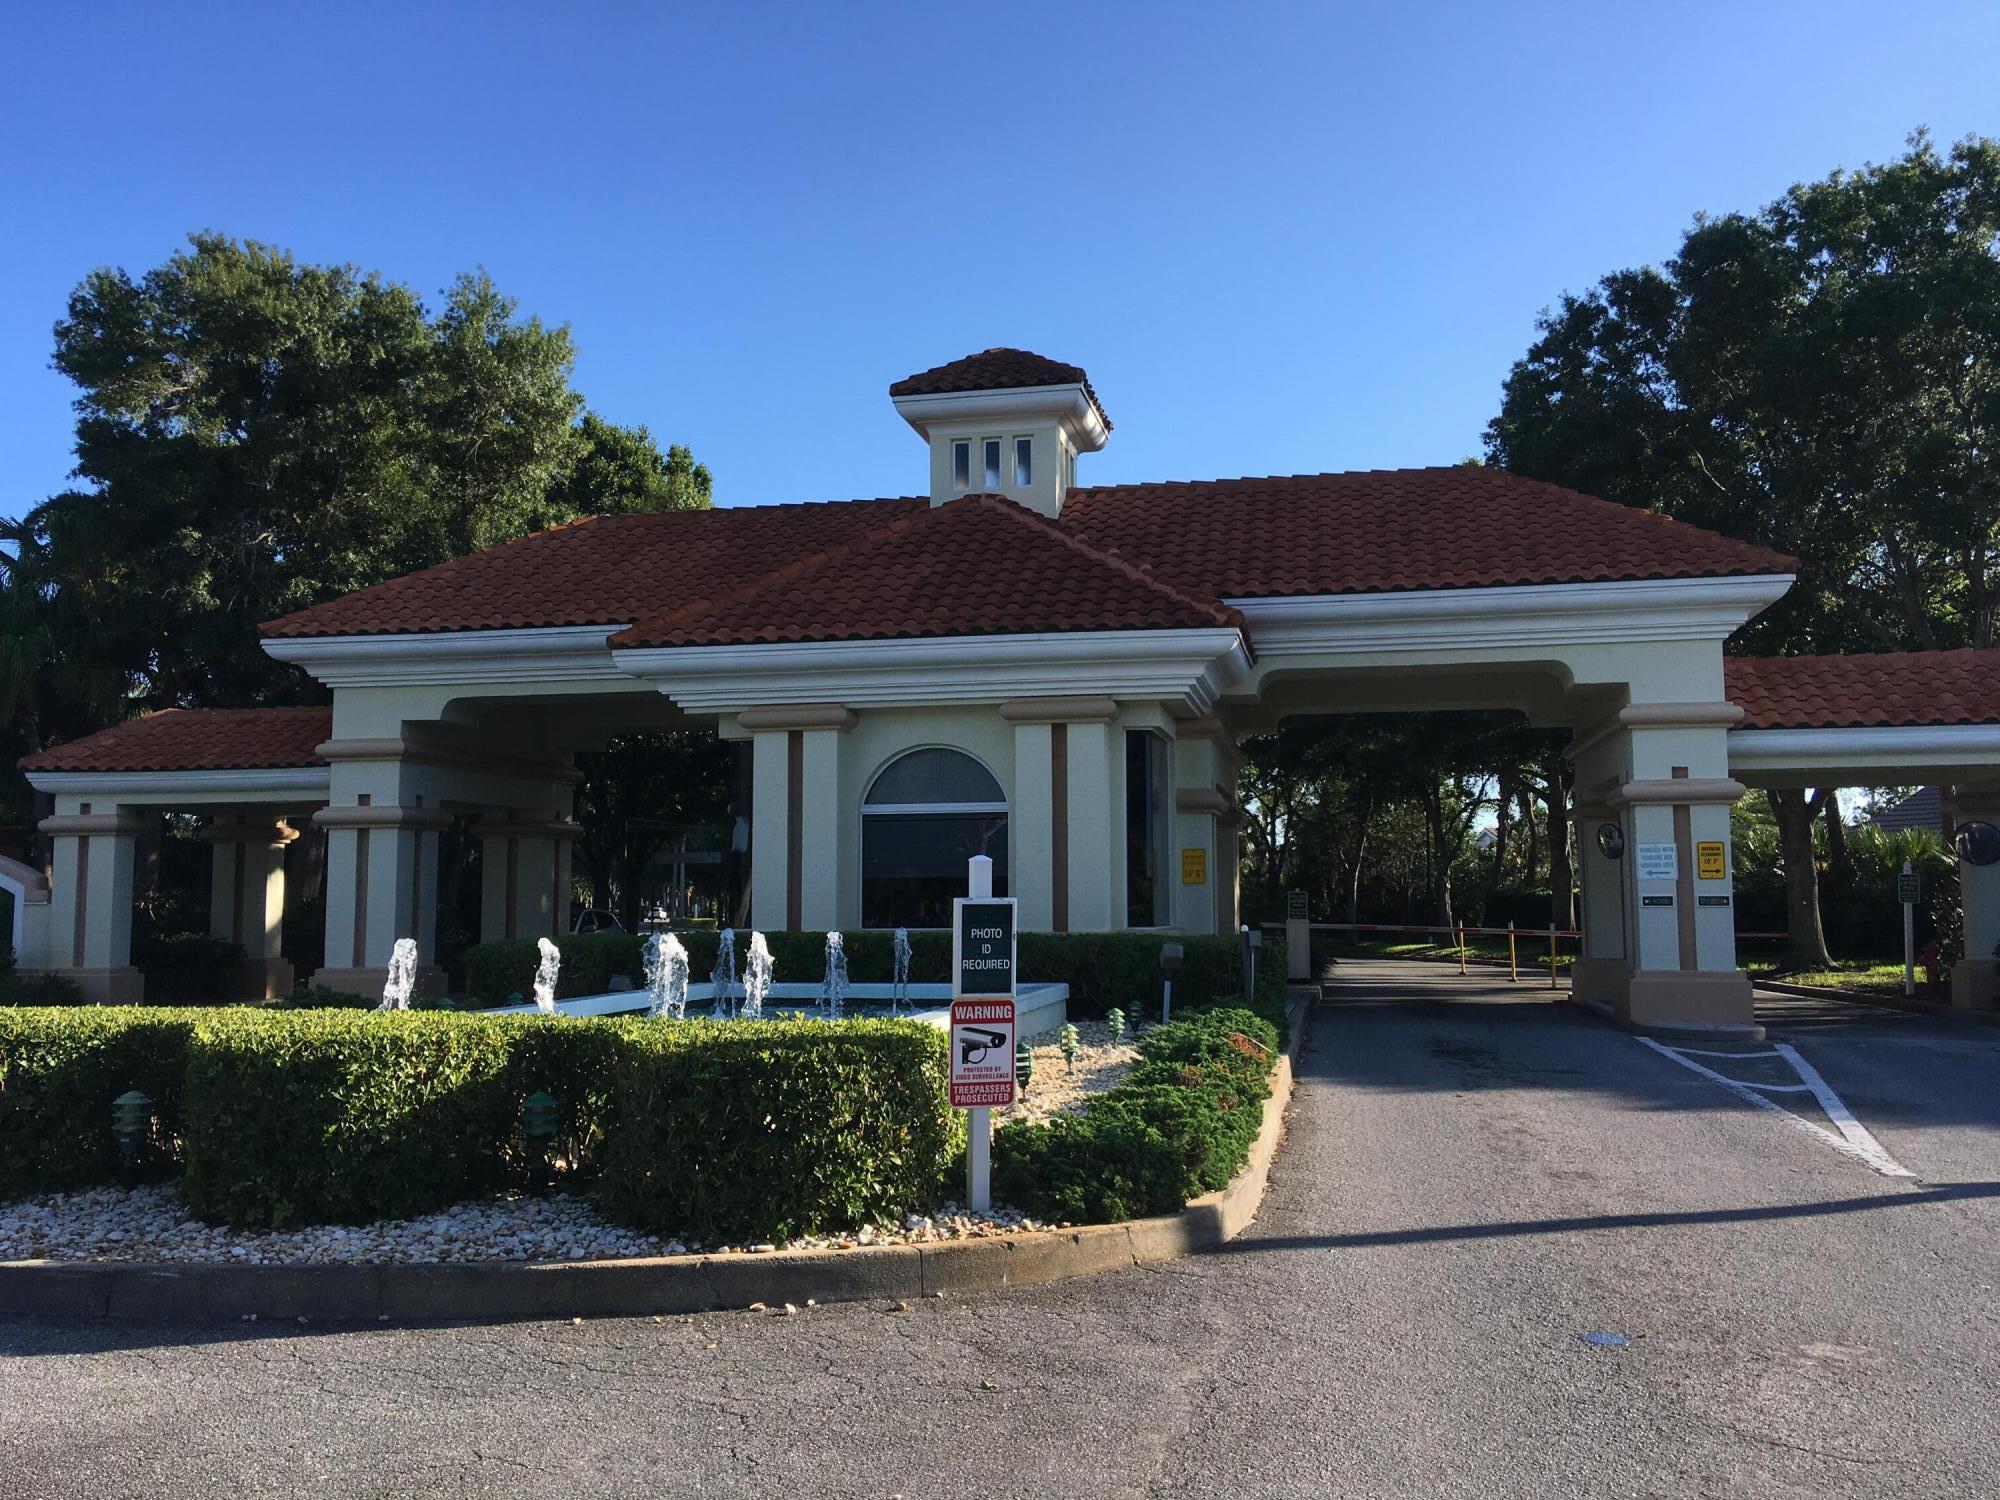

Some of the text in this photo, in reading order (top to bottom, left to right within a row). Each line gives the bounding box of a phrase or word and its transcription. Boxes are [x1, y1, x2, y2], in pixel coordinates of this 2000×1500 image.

[971, 928, 1003, 939] PHOTO
[981, 944, 992, 954] ID
[962, 959, 1011, 970] REQUIRED
[955, 1005, 1013, 1020] WARNING
[972, 1072, 1009, 1080] SURVEILLANCE
[953, 1084, 1011, 1095] TRESPASSERS
[955, 1093, 1009, 1104] PROSECUTED
